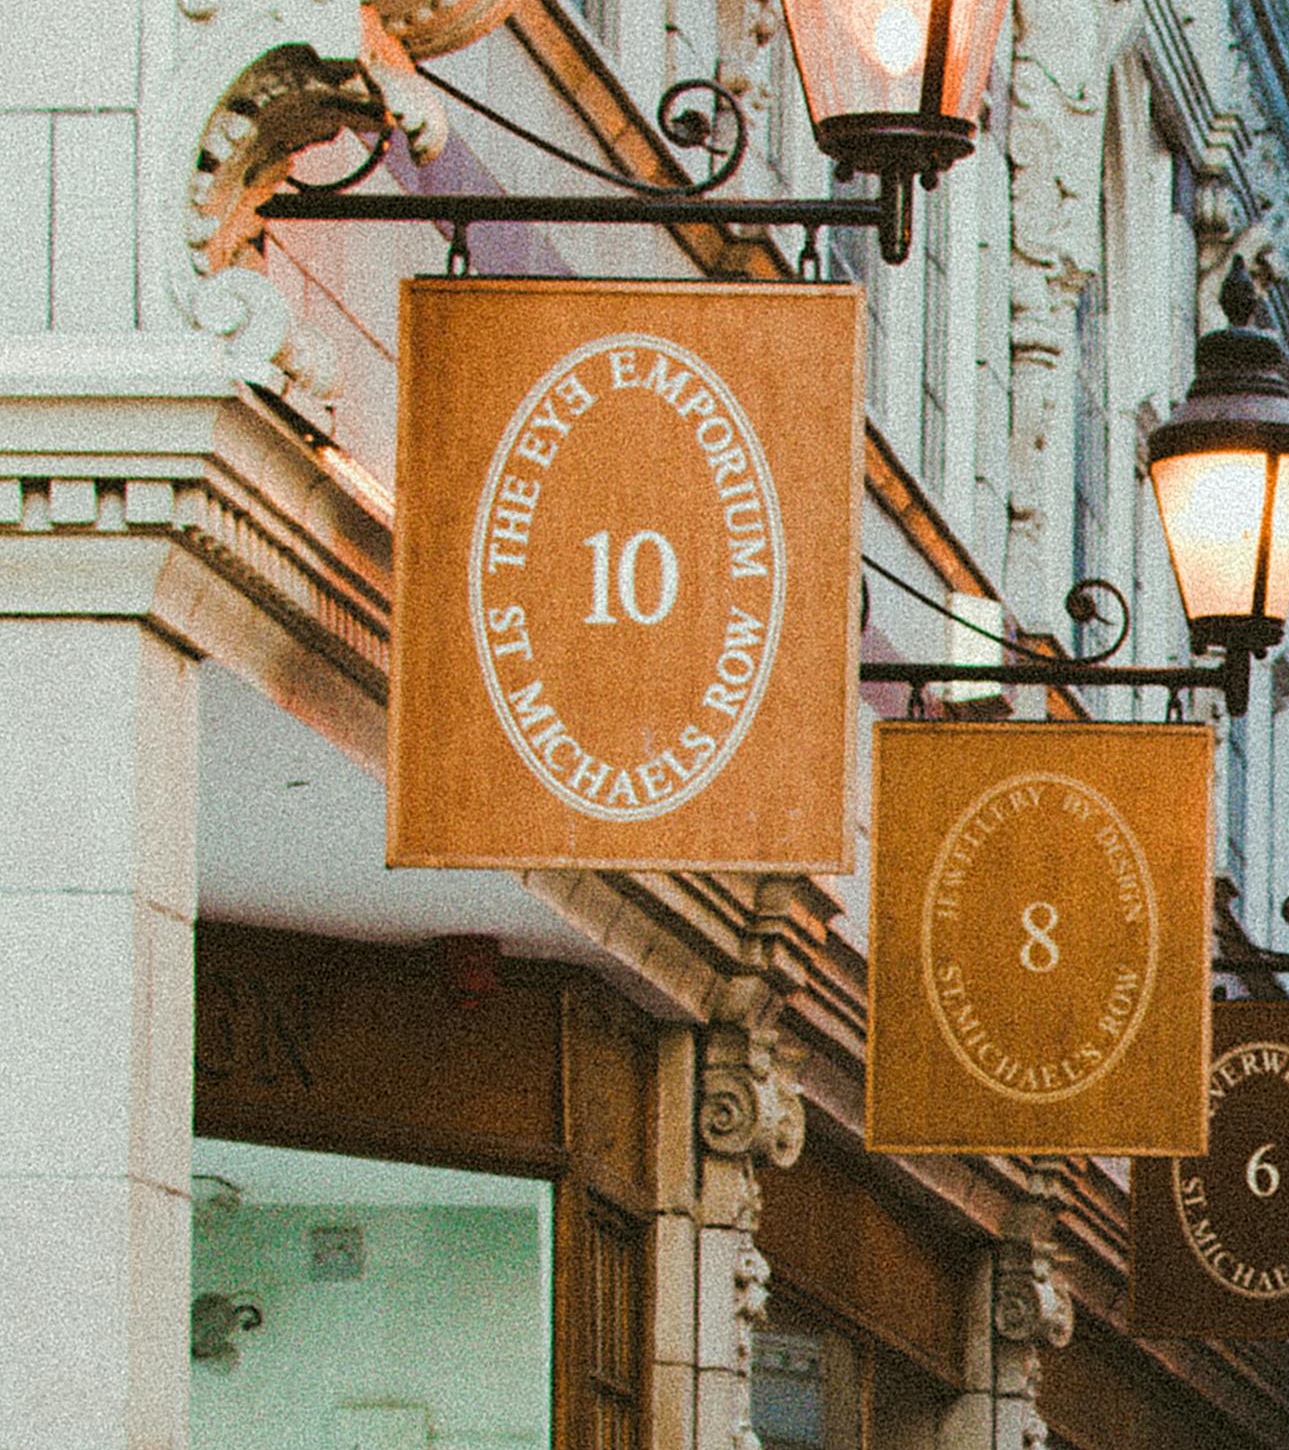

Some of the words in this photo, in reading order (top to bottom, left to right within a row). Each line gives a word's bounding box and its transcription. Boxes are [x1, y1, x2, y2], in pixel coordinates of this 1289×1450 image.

[488, 476, 540, 575] THE
[607, 349, 769, 581] EMPORIUM
[582, 528, 679, 625] 10
[488, 604, 533, 663] ST
[702, 607, 767, 718] ROW
[507, 679, 720, 806] MICHAELS
[936, 786, 1046, 922] JEWELLERY
[1062, 796, 1092, 823] BY
[1096, 824, 1143, 923] DESIGN
[1019, 901, 1060, 972] 8
[1098, 964, 1140, 1036] ROW
[1246, 1142, 1281, 1199] 6
